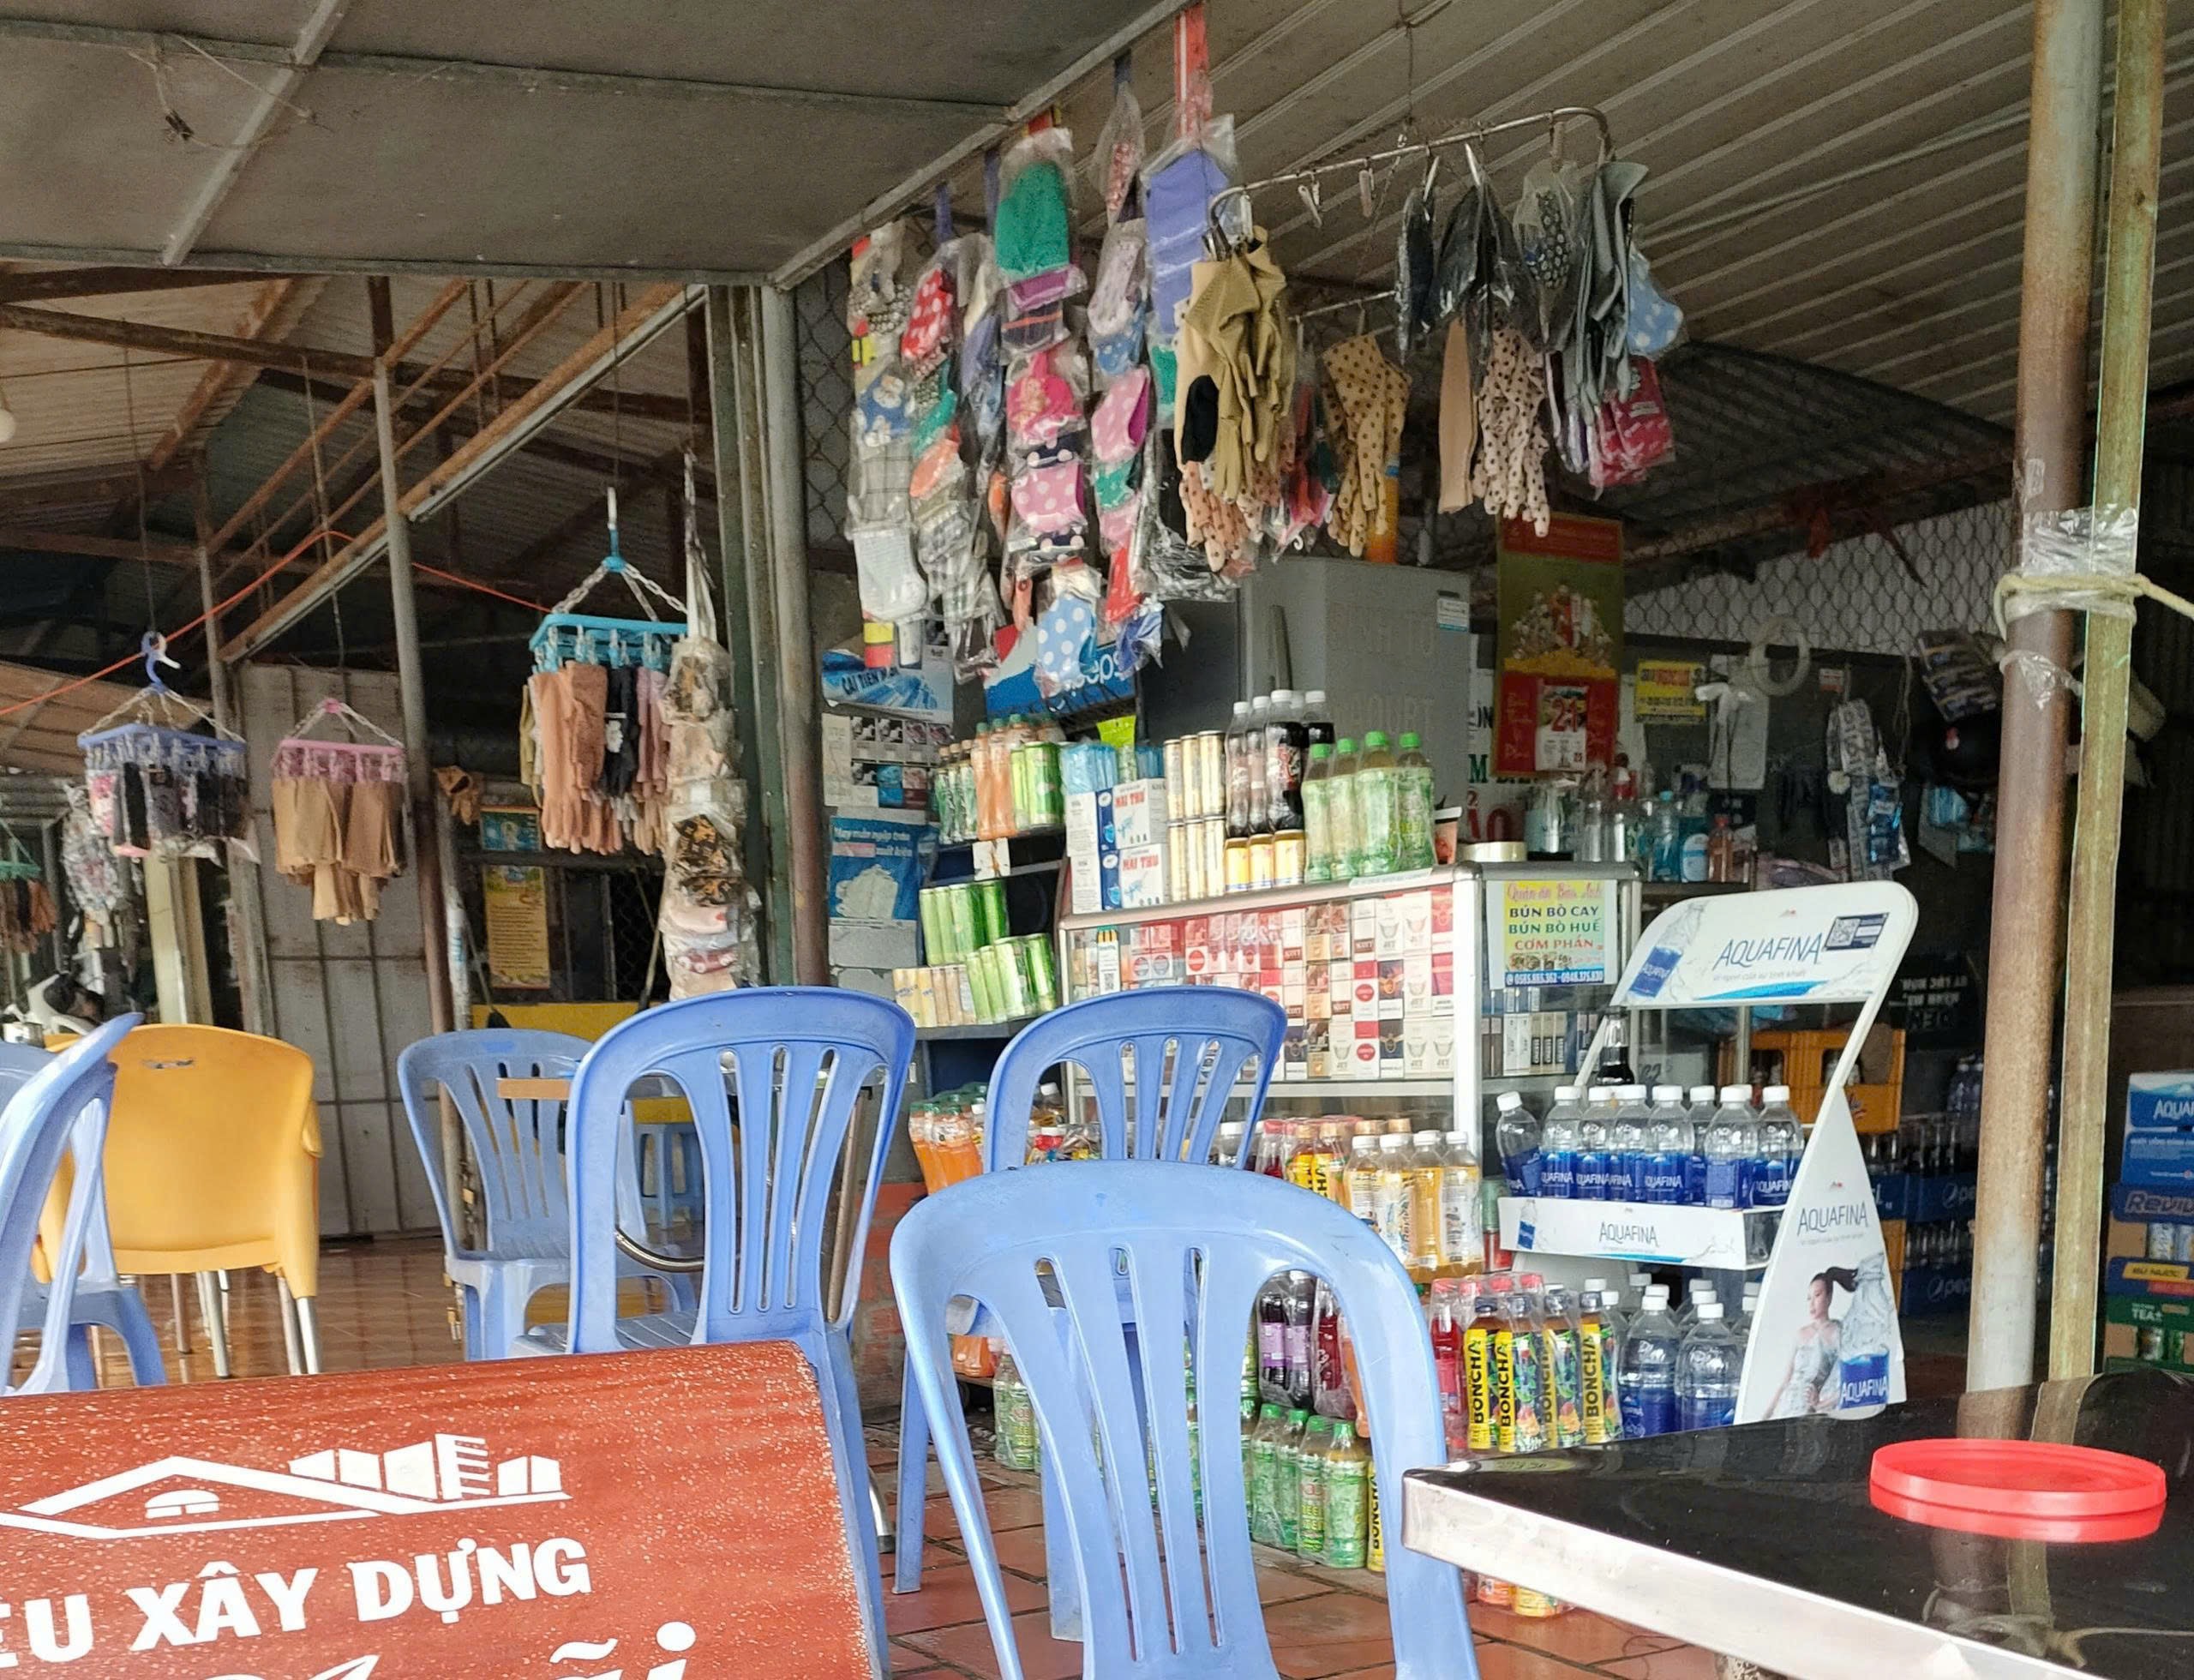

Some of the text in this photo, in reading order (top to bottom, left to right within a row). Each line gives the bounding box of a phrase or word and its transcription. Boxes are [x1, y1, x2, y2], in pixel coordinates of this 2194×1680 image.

[1508, 921, 1541, 934] BÚN
[1545, 919, 1566, 933] BÒ
[1509, 904, 1599, 918] BÚN BÒ CAY
[1514, 938, 1549, 951] CƠM
[1711, 932, 1823, 972] AQUAFINA
[1598, 1221, 1660, 1248] AQUAFINA
[1797, 1202, 1869, 1237] AQUAFINA
[1467, 1339, 1484, 1425] BONCHA
[1496, 1343, 1512, 1428] BONCHA
[1583, 1335, 1600, 1418] BONCHA
[1842, 1377, 1888, 1402] AQUAFINA
[125, 1559, 320, 1653] XÂY
[346, 1537, 594, 1624] DỰNG
